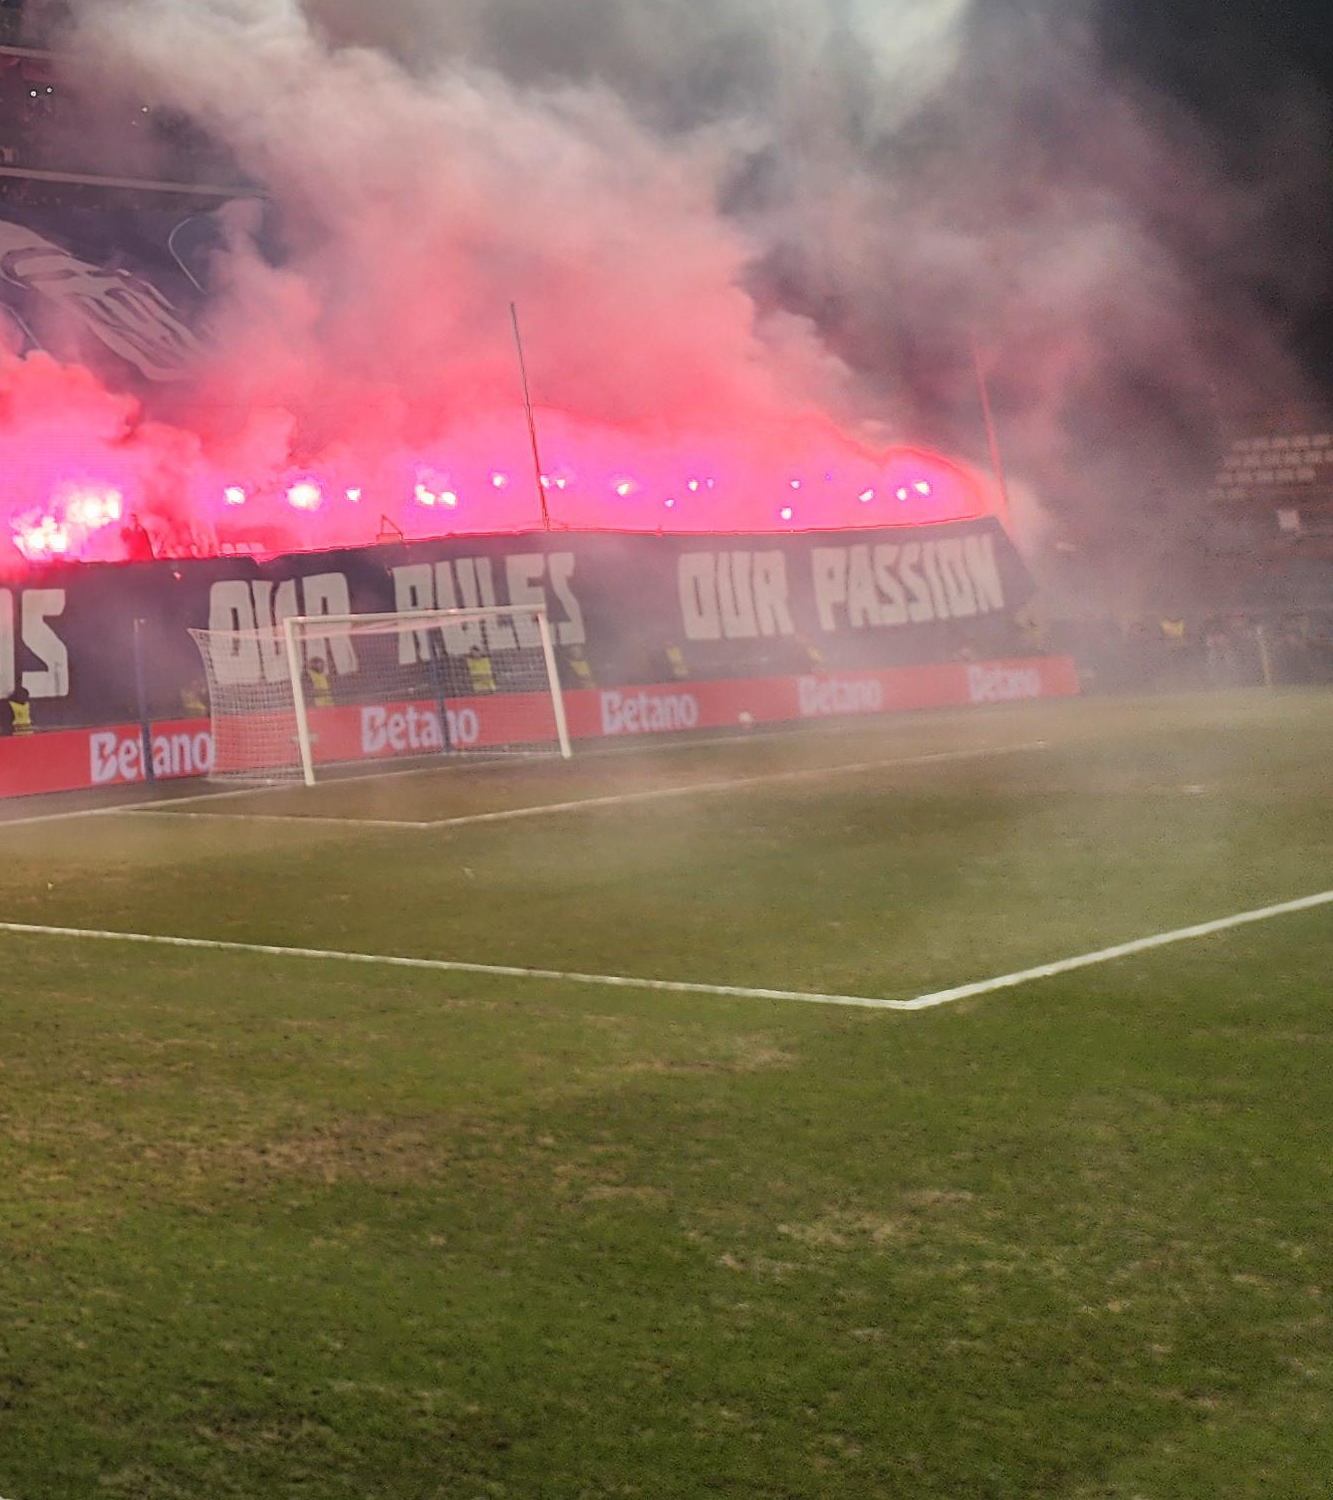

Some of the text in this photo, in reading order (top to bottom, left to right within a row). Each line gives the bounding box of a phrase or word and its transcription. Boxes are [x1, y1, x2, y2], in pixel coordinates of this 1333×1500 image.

[677, 550, 794, 640] OUR
[811, 533, 1004, 632] PASSION
[798, 674, 884, 716] Betano
[968, 663, 1042, 702] Betano
[601, 690, 699, 735] Betano
